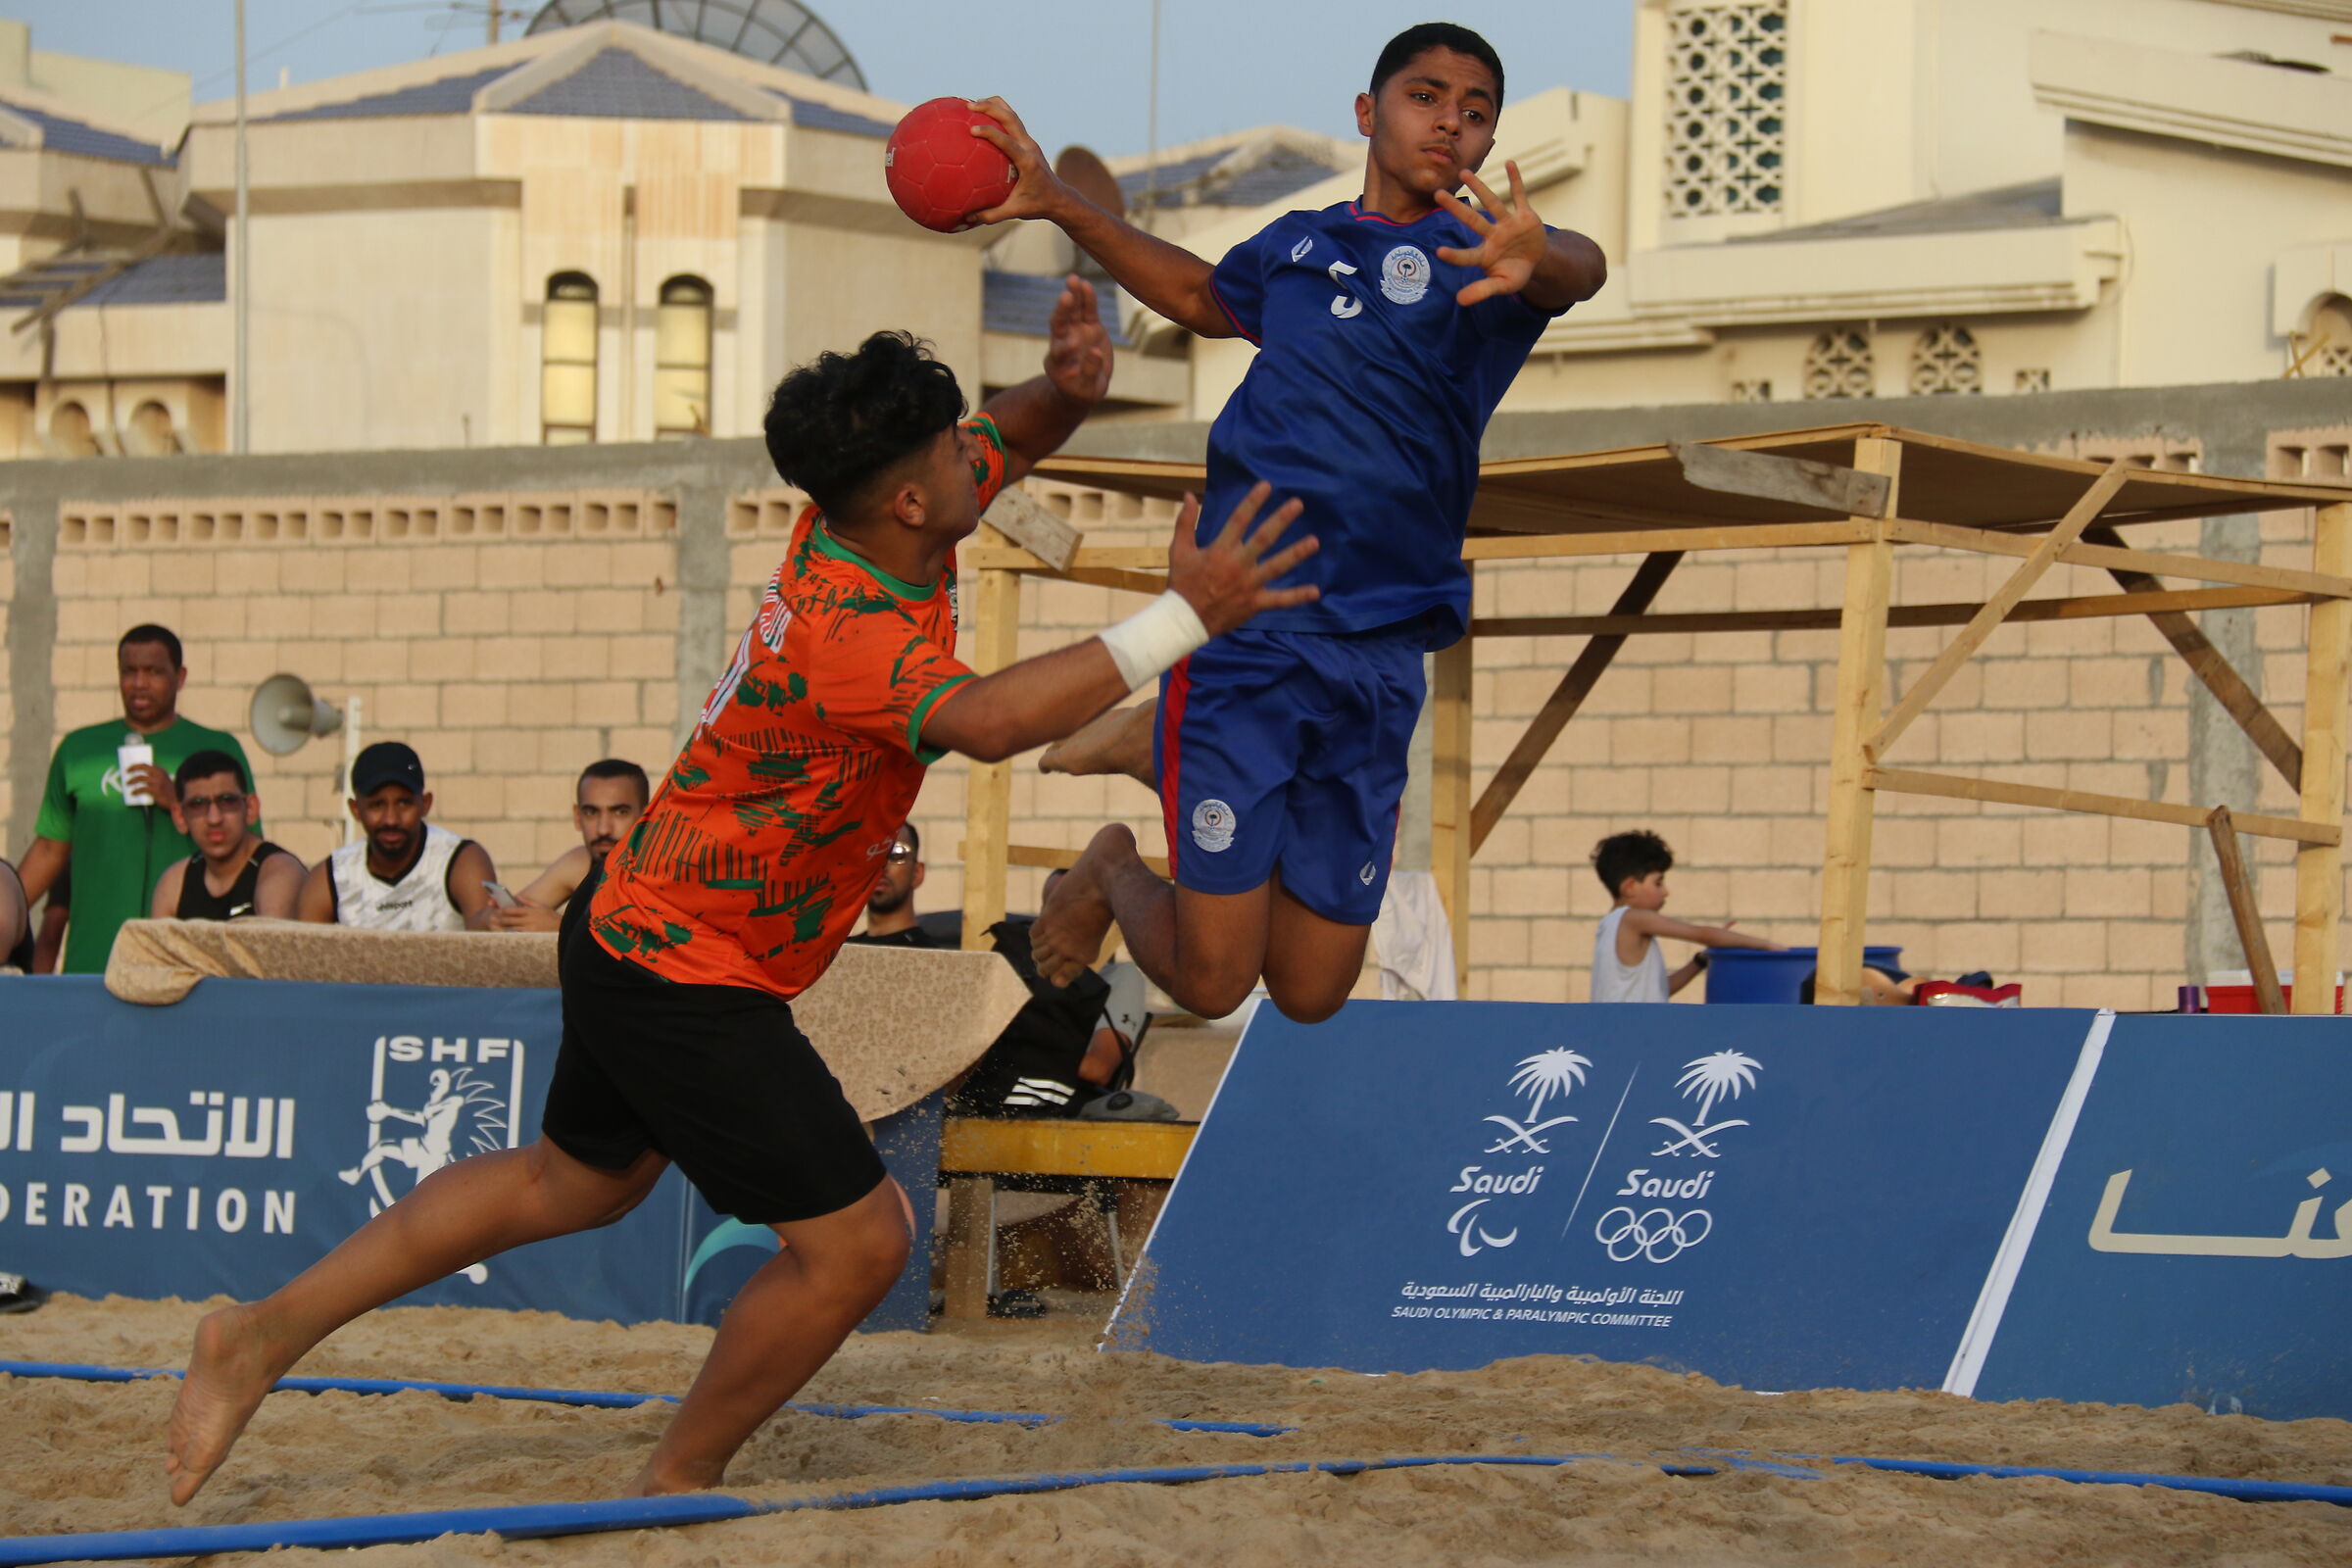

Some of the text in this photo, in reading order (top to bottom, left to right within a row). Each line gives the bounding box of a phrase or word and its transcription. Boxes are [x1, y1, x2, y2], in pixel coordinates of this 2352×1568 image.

[1328, 260, 1363, 318] 5
[388, 1035, 511, 1063] SHF
[60, 1091, 295, 1159] الاتحاد
[1449, 1165, 1544, 1195] Saudi
[1616, 1169, 1715, 1200] Saudi
[1400, 1281, 1685, 1308] اللجنة الأولمبية والبارالمبية السعودية
[1391, 1306, 1673, 1328] SAUDI OLYMPIC & PARALYMPIC COMMITTEE
